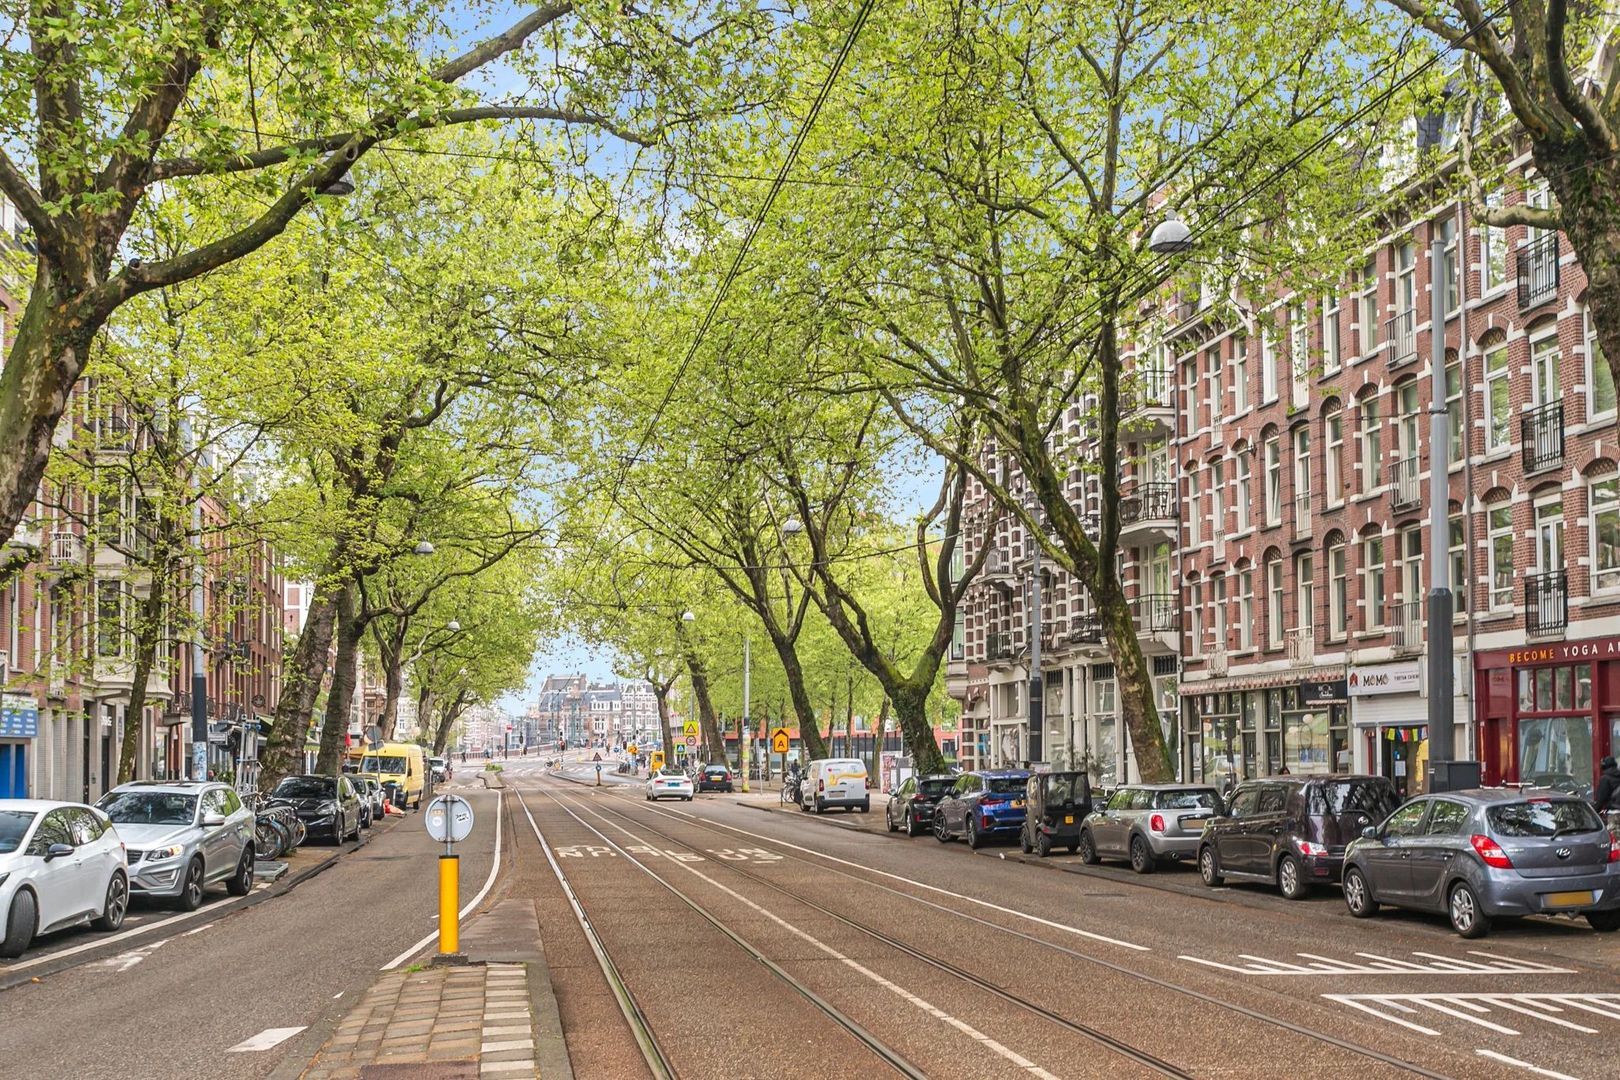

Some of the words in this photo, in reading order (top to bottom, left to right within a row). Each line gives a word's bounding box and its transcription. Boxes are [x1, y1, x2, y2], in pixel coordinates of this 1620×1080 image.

[1508, 648, 1555, 663] BECOME
[1563, 643, 1598, 657] YOGA
[1363, 673, 1389, 687] MOMO
[777, 740, 785, 748] A
